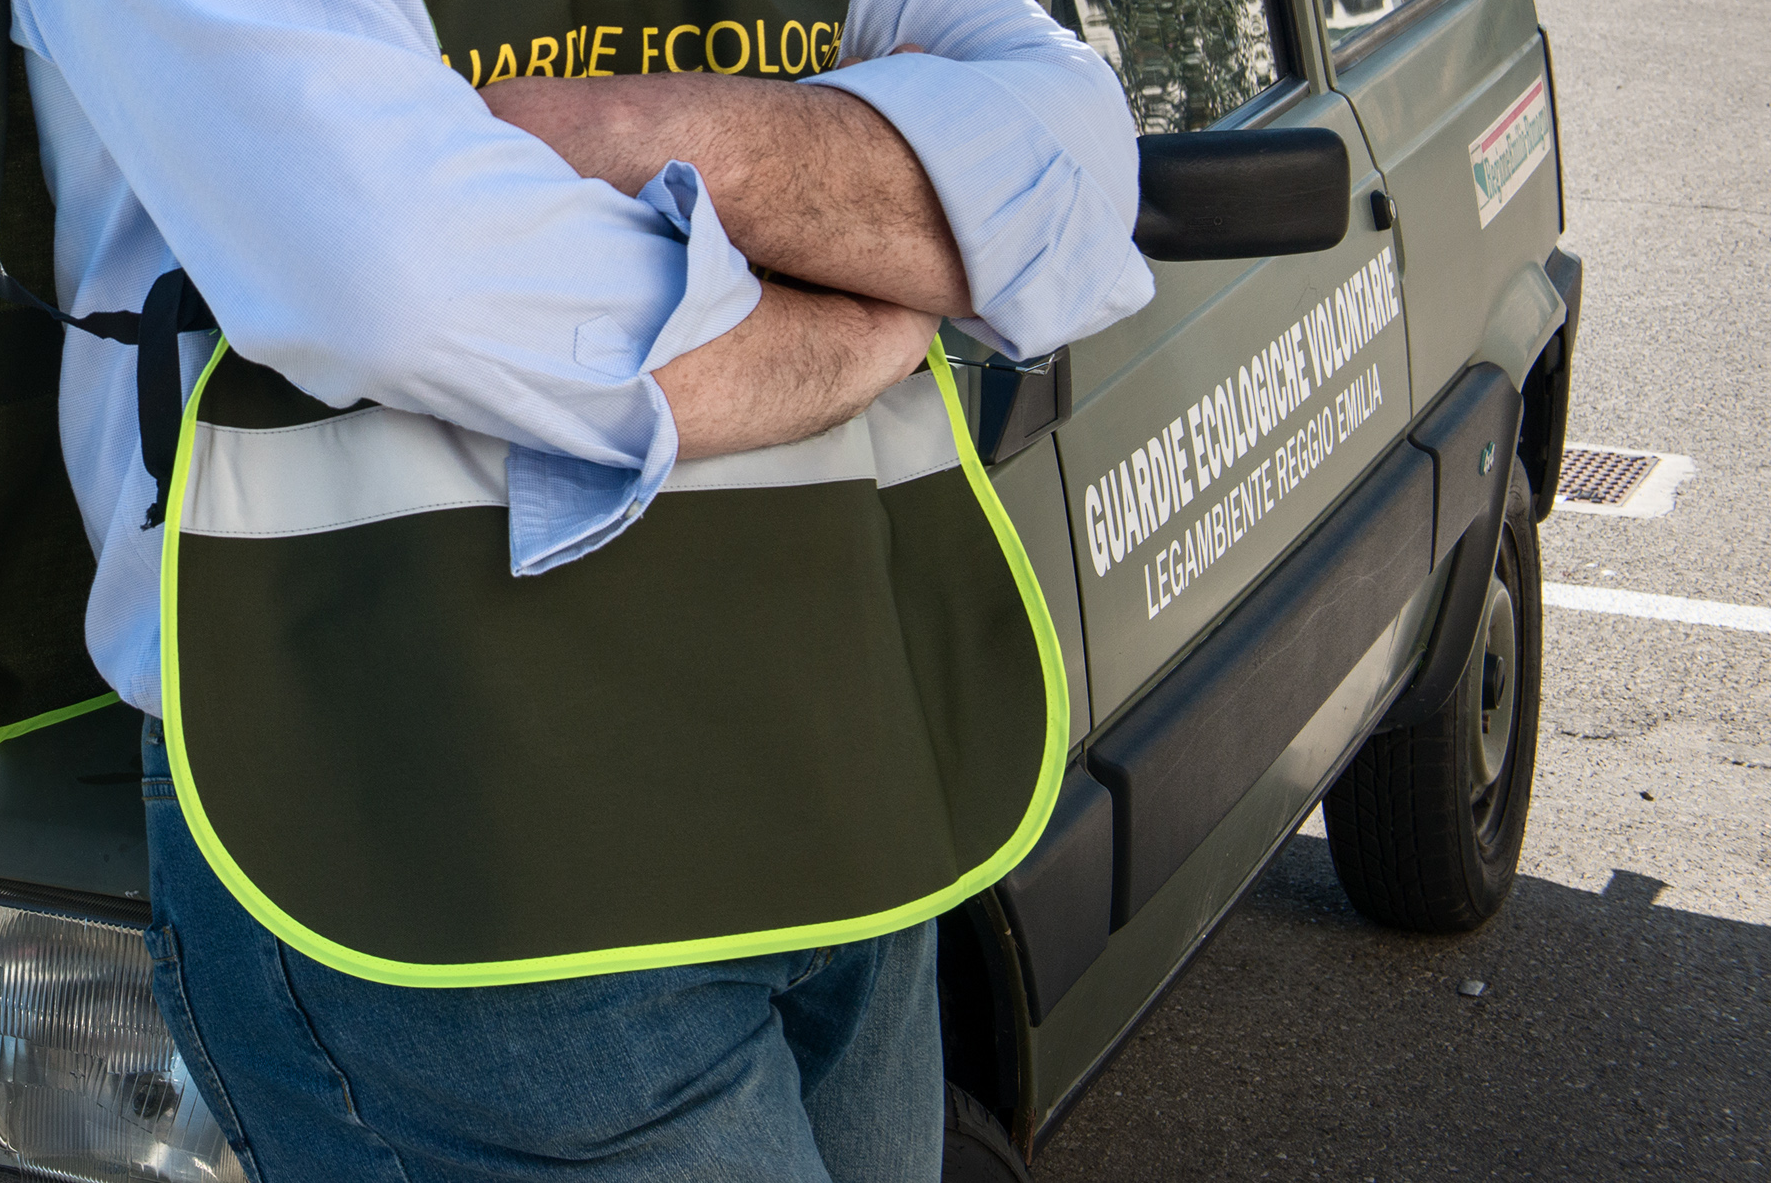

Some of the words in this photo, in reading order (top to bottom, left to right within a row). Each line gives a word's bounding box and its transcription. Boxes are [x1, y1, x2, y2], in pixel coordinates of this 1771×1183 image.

[1084, 416, 1195, 578] GUARDIE
[1186, 321, 1311, 492] ECOLOGICHE
[1302, 245, 1400, 388] VOLONTARIE
[1143, 458, 1275, 620] LEGAMBIENTE
[1275, 405, 1335, 500] REGGIO
[1335, 362, 1383, 445] EMILIA
